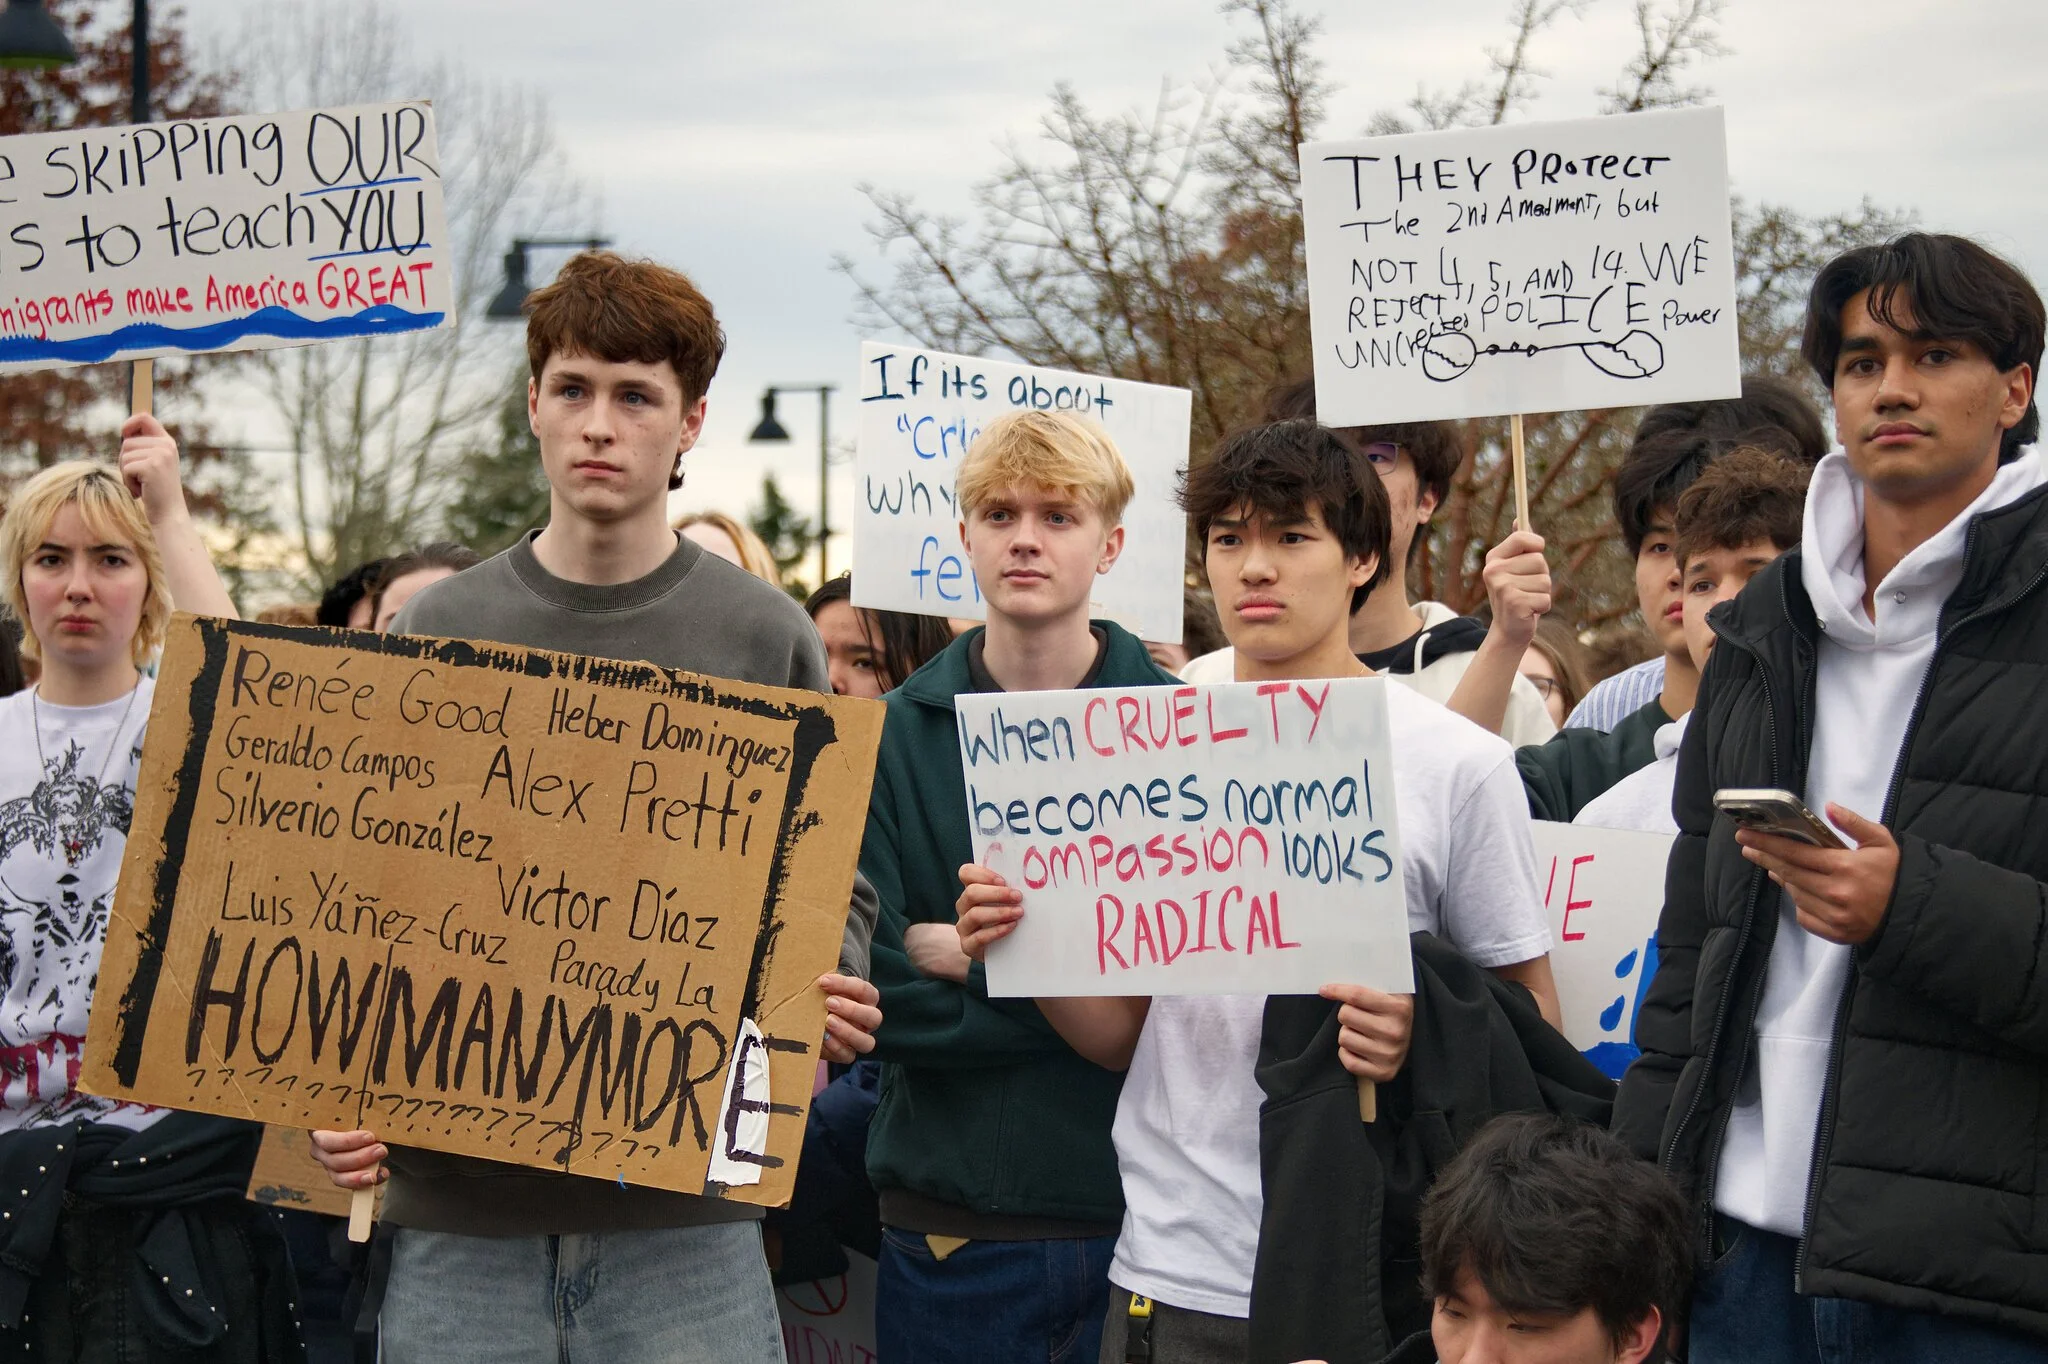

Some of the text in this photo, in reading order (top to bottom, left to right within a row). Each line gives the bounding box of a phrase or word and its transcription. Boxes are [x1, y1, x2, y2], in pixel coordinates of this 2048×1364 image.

[306, 107, 440, 186] OUR
[1322, 154, 1493, 210] THEY
[65, 215, 141, 273] to
[156, 192, 314, 257] teach
[321, 189, 424, 257] YOU
[1339, 208, 1420, 243] The
[1351, 257, 1419, 293] NOT
[1523, 260, 1574, 292] AND
[1639, 235, 1710, 286] WE
[126, 285, 194, 316] make
[205, 274, 308, 313] America
[316, 262, 434, 310] GREAT
[860, 354, 1114, 420] If its about
[910, 535, 980, 604] fe
[231, 644, 374, 721] Renée
[399, 668, 513, 738] Good
[547, 686, 632, 744] Heber
[959, 681, 1331, 768] When CRUELTY
[215, 765, 494, 863] Silverio González
[225, 714, 763, 857] Geraldo Campos Alex Pretti
[969, 758, 1374, 837] becomes normal
[219, 860, 294, 927] Luis
[628, 877, 720, 952] Díaz
[1094, 885, 1302, 976] RADICAL
[184, 925, 383, 1075] HOW
[549, 937, 719, 1015] Parady La
